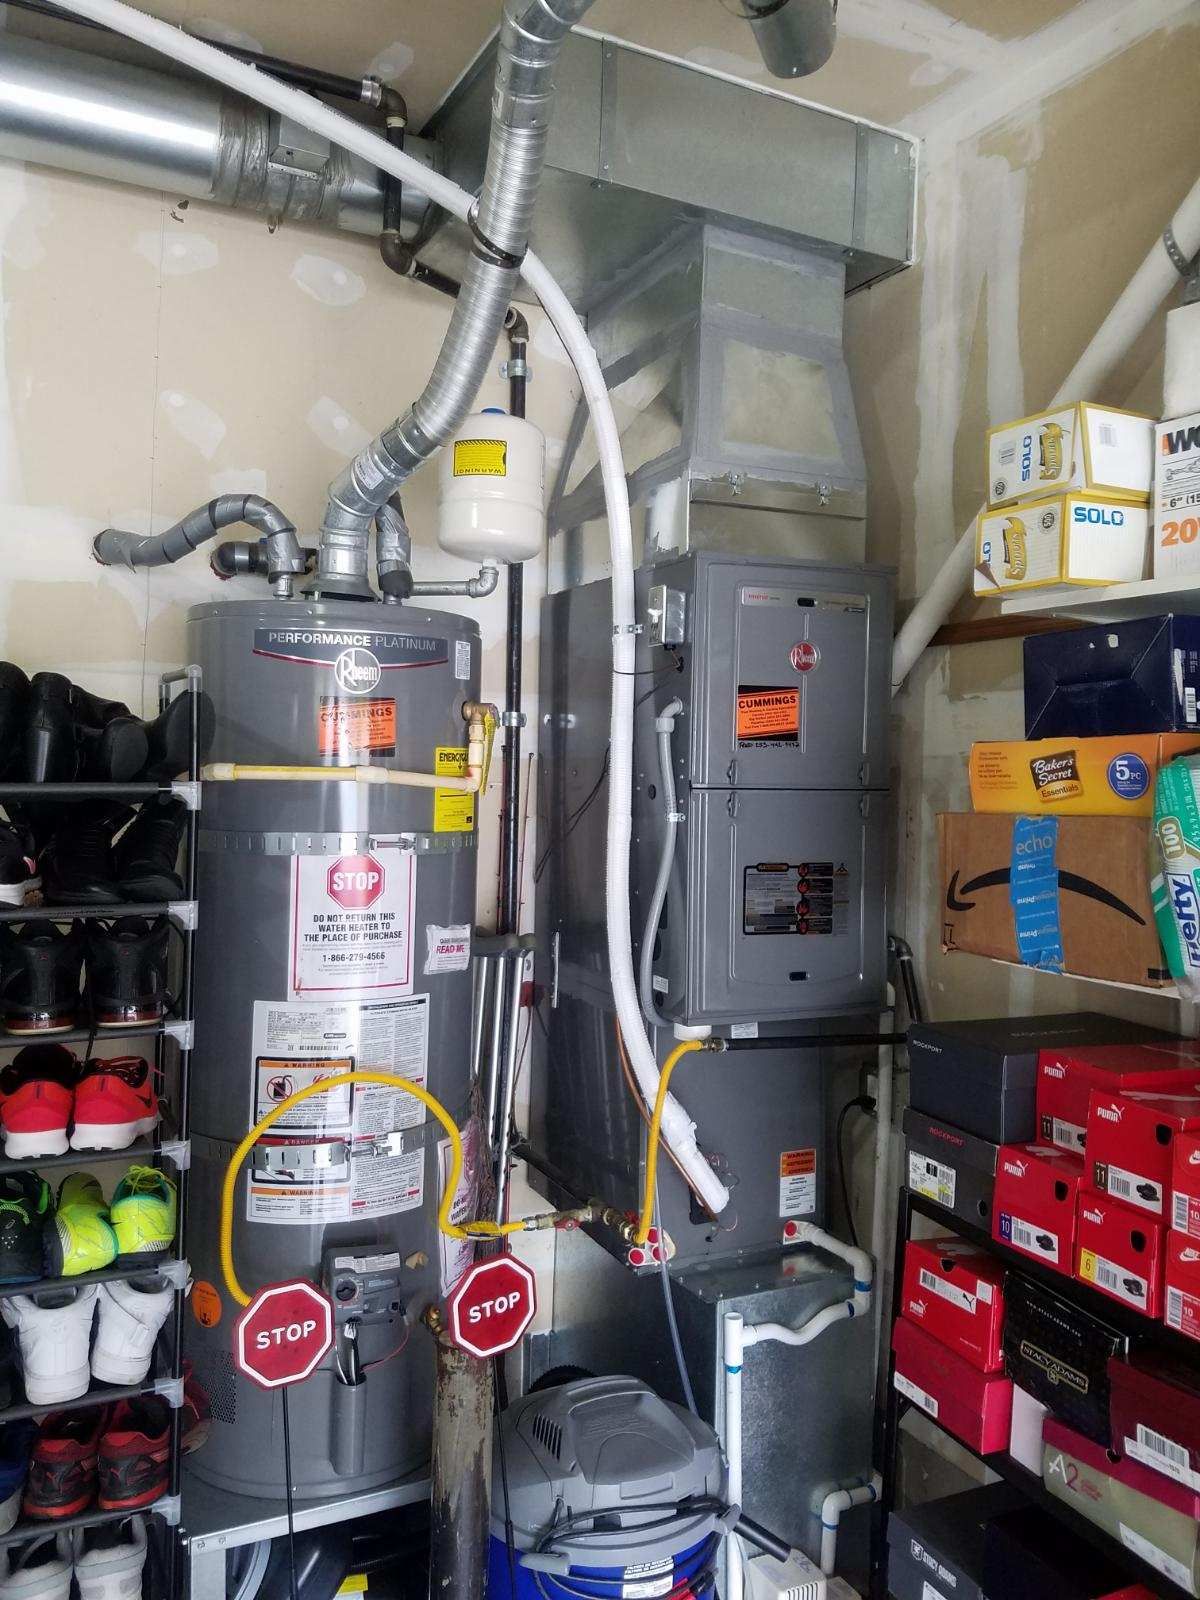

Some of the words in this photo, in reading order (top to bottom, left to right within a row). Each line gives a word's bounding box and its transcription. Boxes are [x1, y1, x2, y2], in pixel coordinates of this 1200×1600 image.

[1021, 434, 1032, 482] SOLO
[1074, 506, 1124, 526] SOLO
[1161, 517, 1200, 547] 20
[269, 632, 372, 648] PERFORMANCE
[375, 635, 436, 651] PLATINUM
[340, 648, 378, 687] Rheem
[738, 695, 796, 709] CUMMINGS
[1039, 769, 1072, 786] Secret
[1115, 760, 1130, 781] 5
[1130, 772, 1142, 780] PC
[1041, 784, 1079, 798] Essentials
[1015, 833, 1053, 855] echo
[1161, 823, 1182, 855] 100
[333, 872, 380, 891] STOP
[313, 914, 324, 922] DO
[327, 914, 343, 922] NOT
[346, 913, 376, 922] RETURN
[380, 912, 396, 920] THIS
[318, 924, 346, 932] WATER
[349, 923, 379, 931] HEATER
[381, 922, 391, 930] TO
[304, 933, 320, 942] THE
[322, 933, 348, 942] PLACE
[350, 933, 360, 941] OF
[363, 930, 403, 941] PURCHASE
[436, 945, 455, 953] READ
[912, 1039, 943, 1054] ROCKPORT
[1044, 1065, 1063, 1079] PUMA
[1097, 1106, 1118, 1123] PUMA
[929, 1126, 964, 1146] ROCKPORT
[1004, 1161, 1023, 1177] PUMA
[1096, 1169, 1105, 1183] 11
[1083, 1210, 1101, 1225] PUMA
[1001, 1219, 1010, 1234] 10
[1085, 1258, 1091, 1272] 6
[469, 1291, 521, 1323] STOP
[1183, 1306, 1194, 1318] 10
[256, 1319, 317, 1350] STOP
[1023, 1346, 1052, 1366] STACY
[1050, 1362, 1085, 1386] ADAMS
